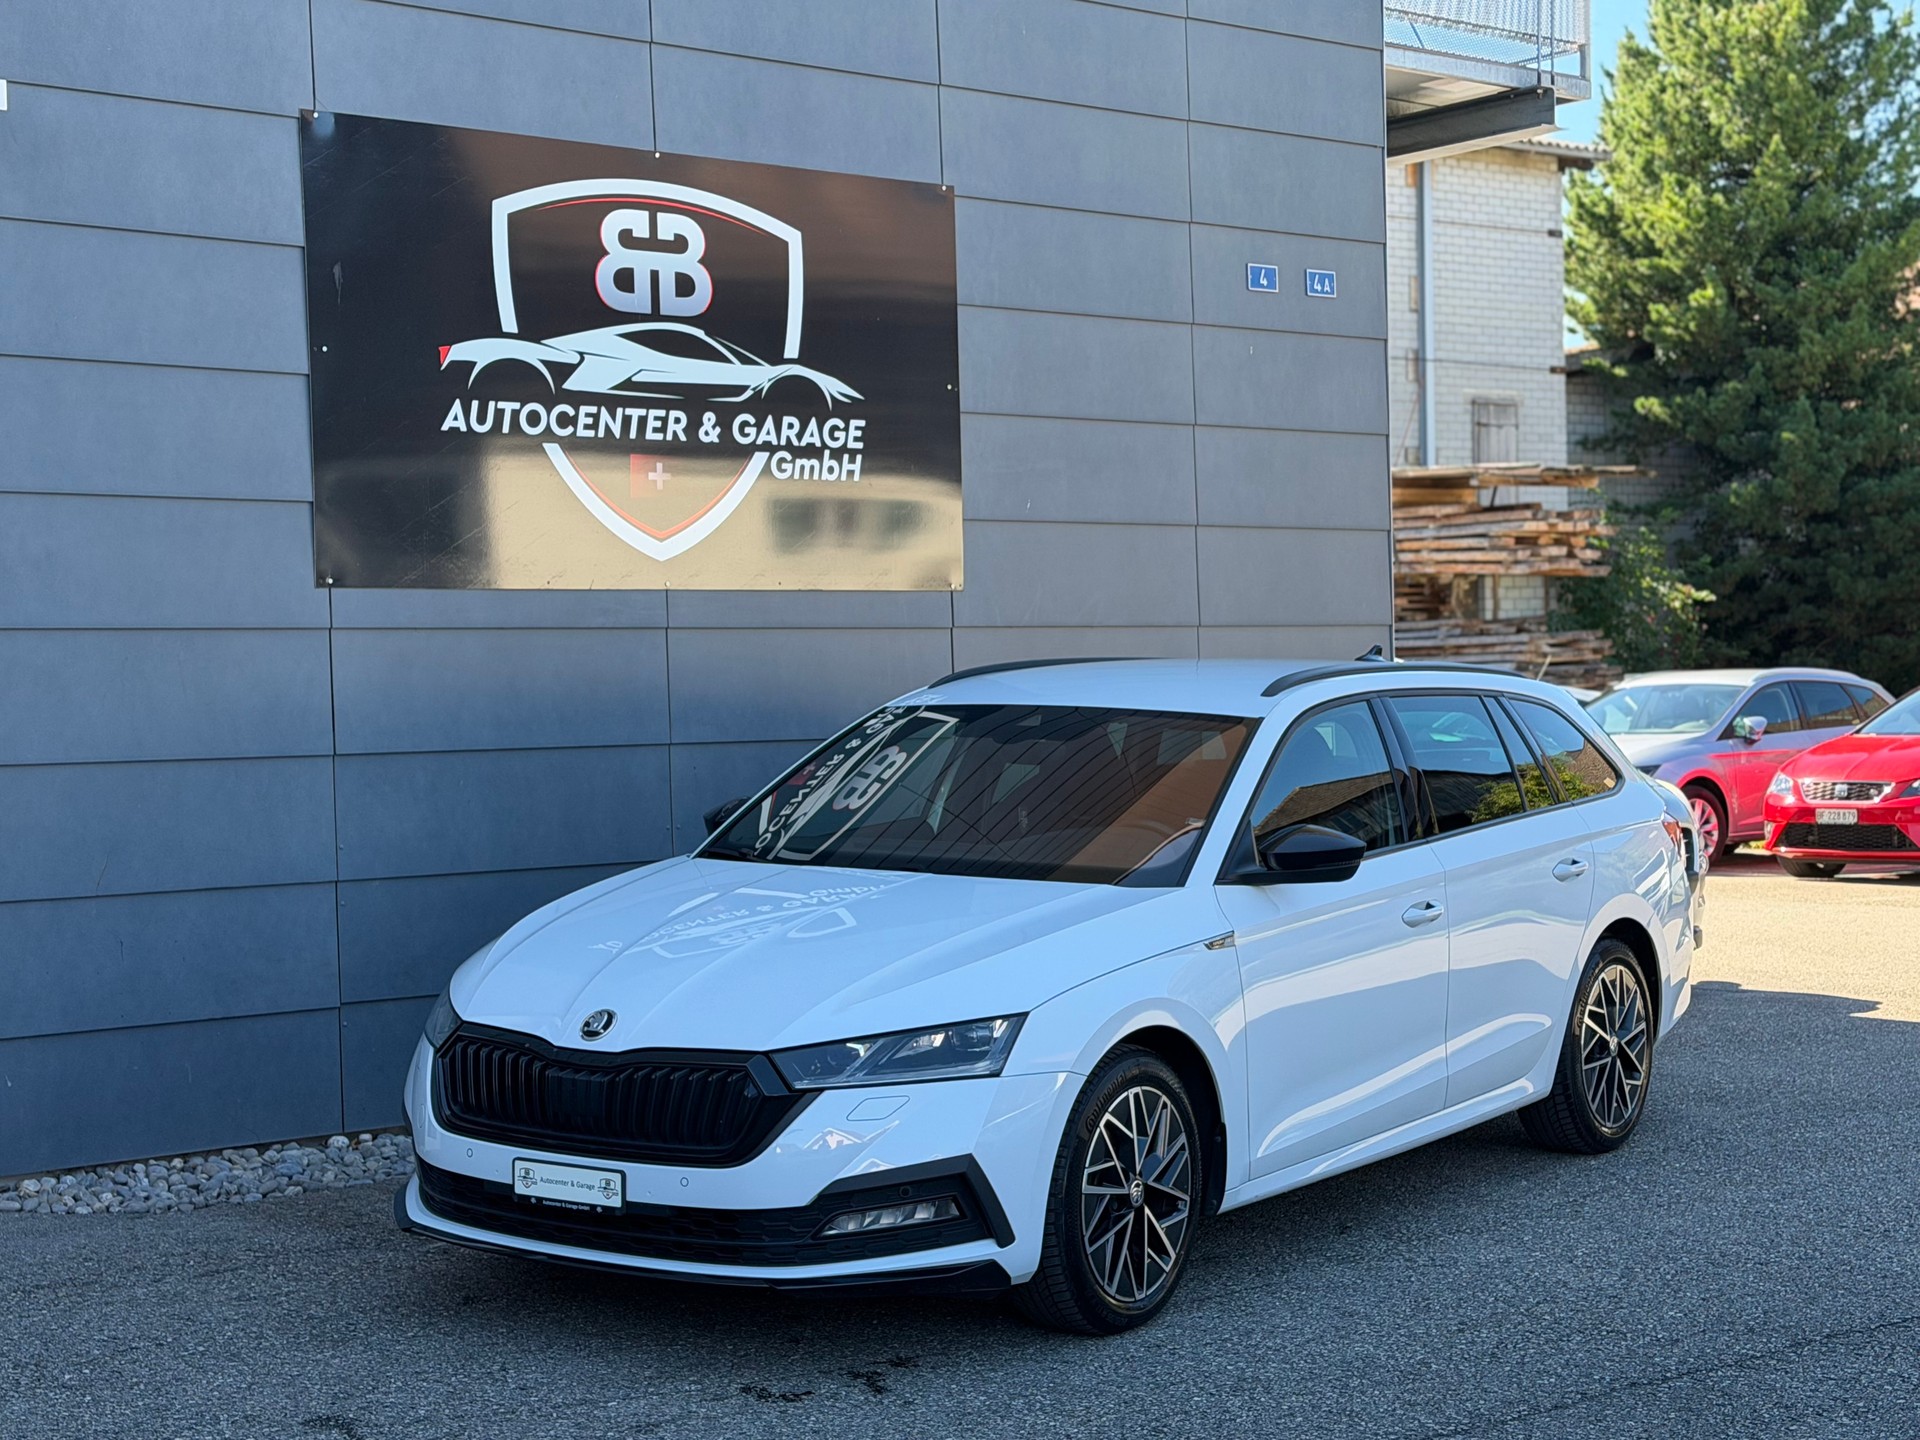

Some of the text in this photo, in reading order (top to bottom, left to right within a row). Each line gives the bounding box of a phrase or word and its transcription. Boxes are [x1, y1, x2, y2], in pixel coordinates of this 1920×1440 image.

[1259, 268, 1268, 287] 4
[1313, 274, 1331, 293] 4A
[440, 398, 867, 450] AUTOCENTER & GARAGE
[770, 449, 863, 482] GmbH
[540, 1176, 570, 1187] Autocenter
[570, 1180, 576, 1188] &
[575, 1181, 596, 1192] Garage
